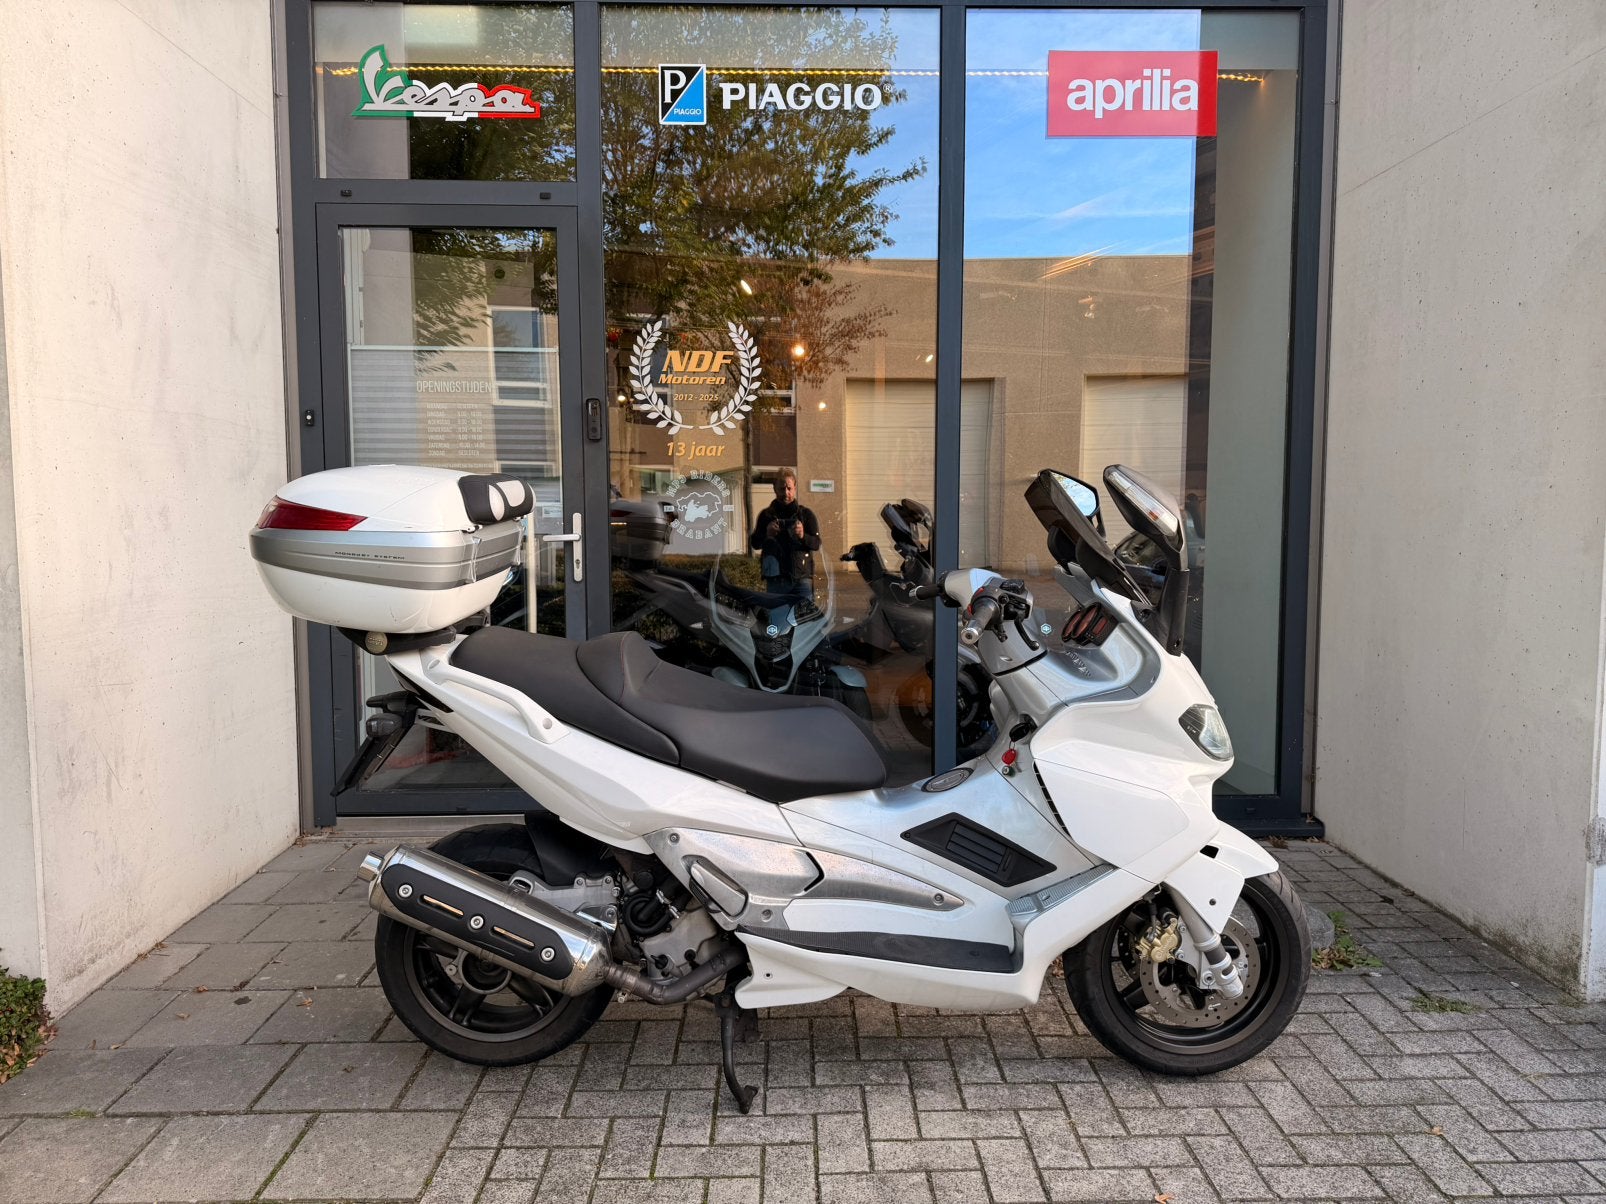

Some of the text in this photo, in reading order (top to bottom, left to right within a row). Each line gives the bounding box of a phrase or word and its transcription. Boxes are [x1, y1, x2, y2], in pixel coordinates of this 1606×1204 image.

[357, 47, 537, 118] Vespa
[663, 69, 687, 103] P
[1066, 68, 1199, 118] aprilia
[719, 82, 882, 110] PIAGGIO
[662, 350, 734, 373] NDF
[658, 374, 726, 385] Motoren
[674, 393, 693, 401] 2012
[700, 393, 719, 401] 2025
[666, 441, 725, 460] 13 jaar
